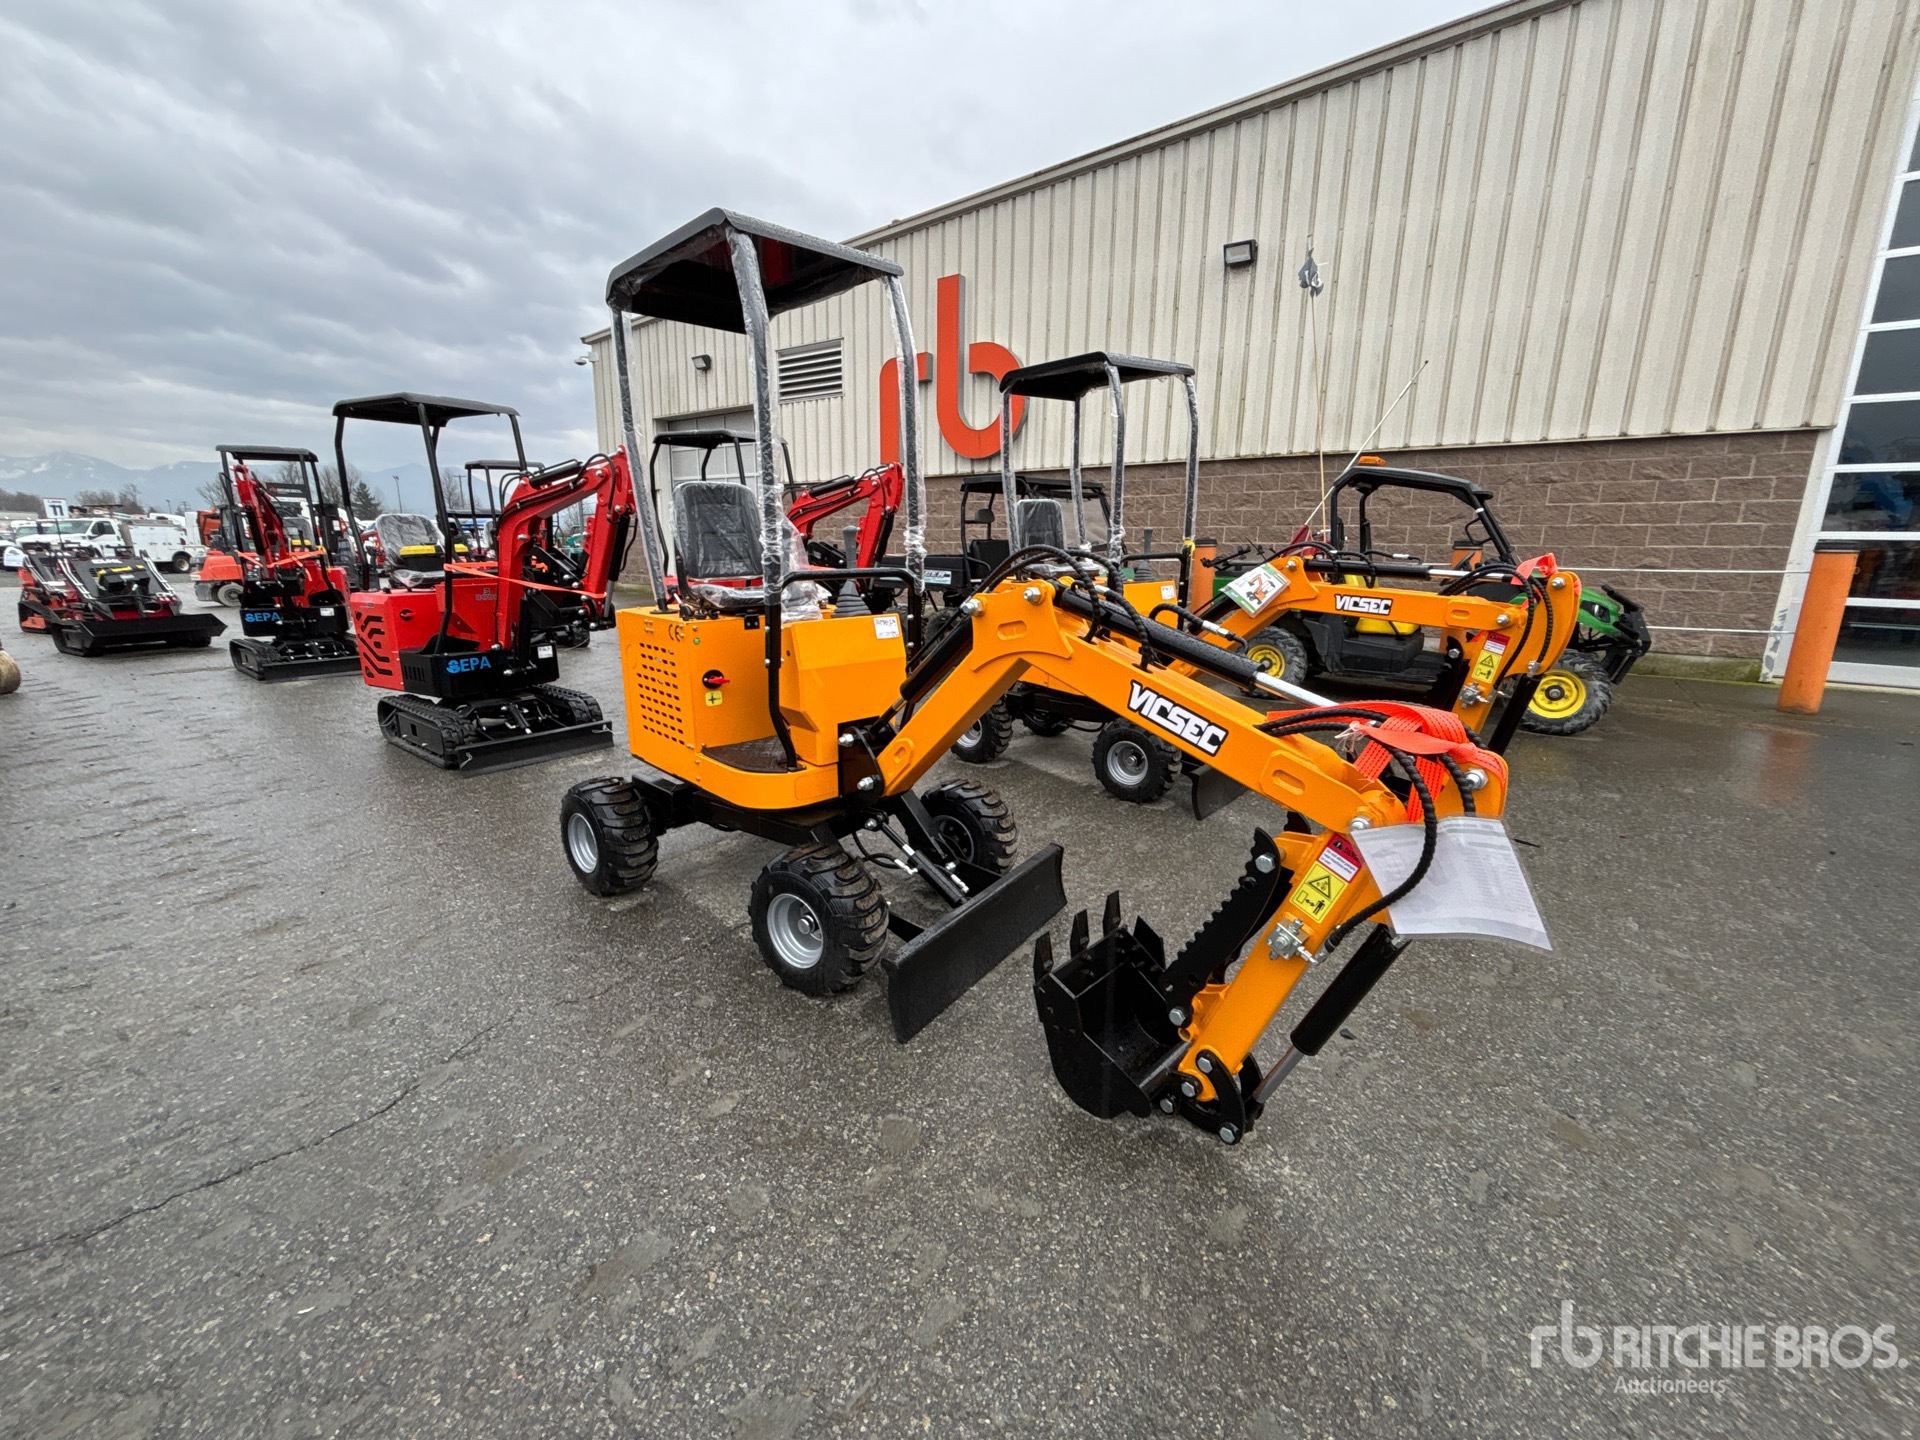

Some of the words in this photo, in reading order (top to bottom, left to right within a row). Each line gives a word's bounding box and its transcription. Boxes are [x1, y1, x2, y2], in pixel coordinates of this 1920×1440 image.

[879, 273, 1029, 464] rb
[1334, 594, 1393, 615] VICSEC
[1128, 680, 1228, 757] VICSEC
